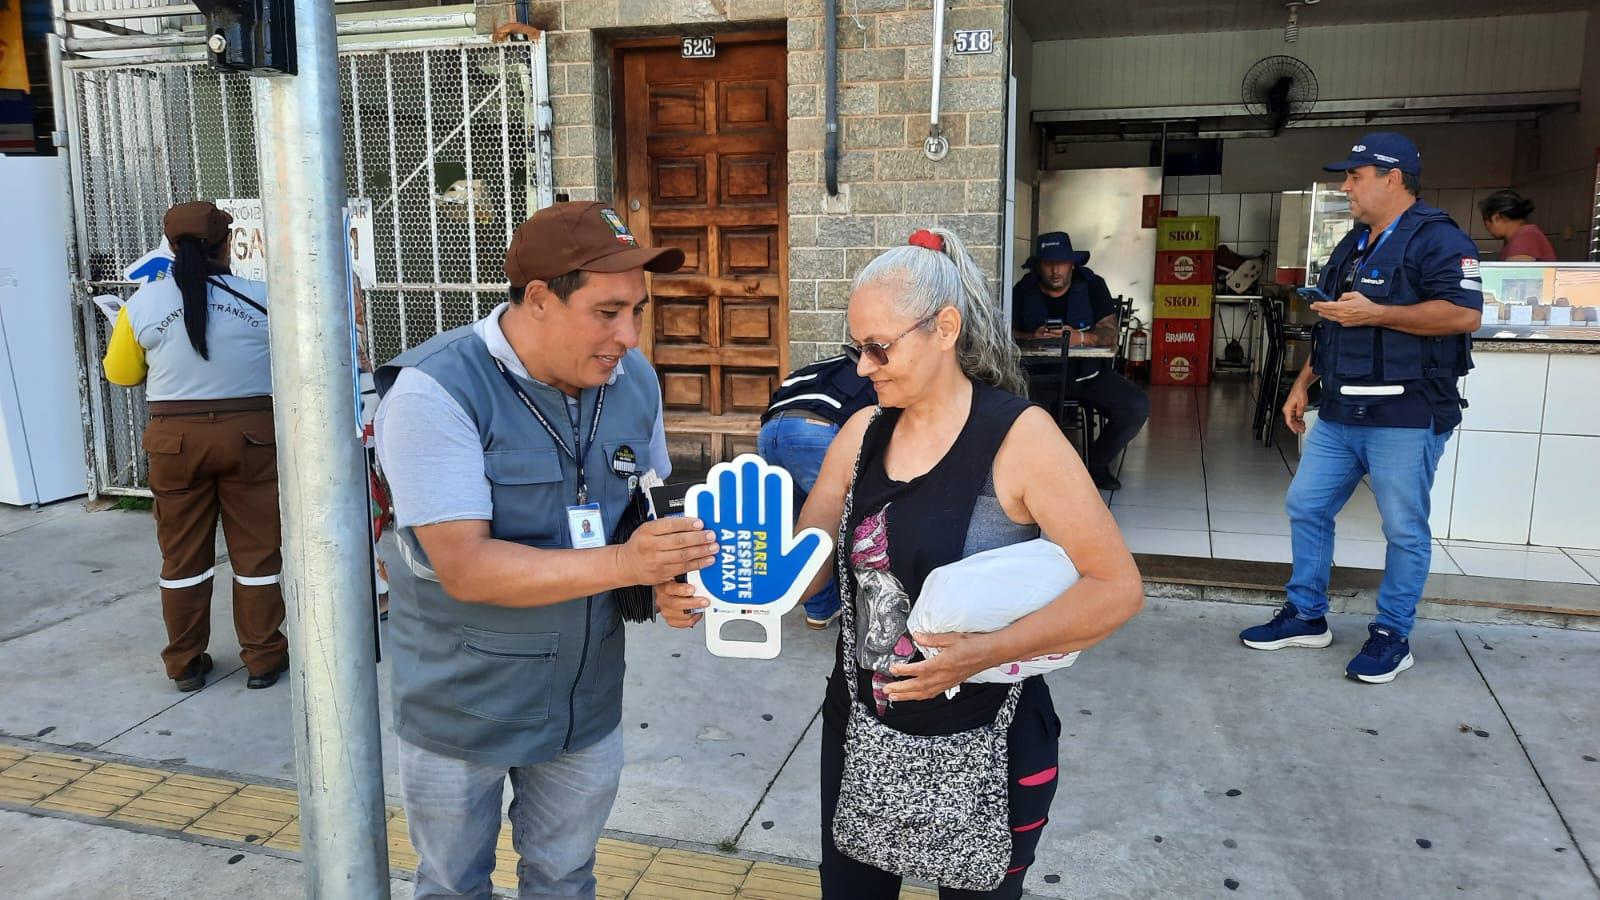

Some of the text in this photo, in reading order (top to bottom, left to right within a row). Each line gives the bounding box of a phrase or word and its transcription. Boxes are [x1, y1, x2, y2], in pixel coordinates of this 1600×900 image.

[956, 31, 990, 51] 518
[1168, 231, 1202, 241] SKOL
[1164, 296, 1200, 307] SKOL
[156, 302, 260, 334] AGENT TRÂNSITO
[1165, 332, 1195, 344] BRAHMA
[721, 529, 736, 541] A
[753, 531, 768, 576] PARE!
[736, 530, 752, 599] RESPEITE
